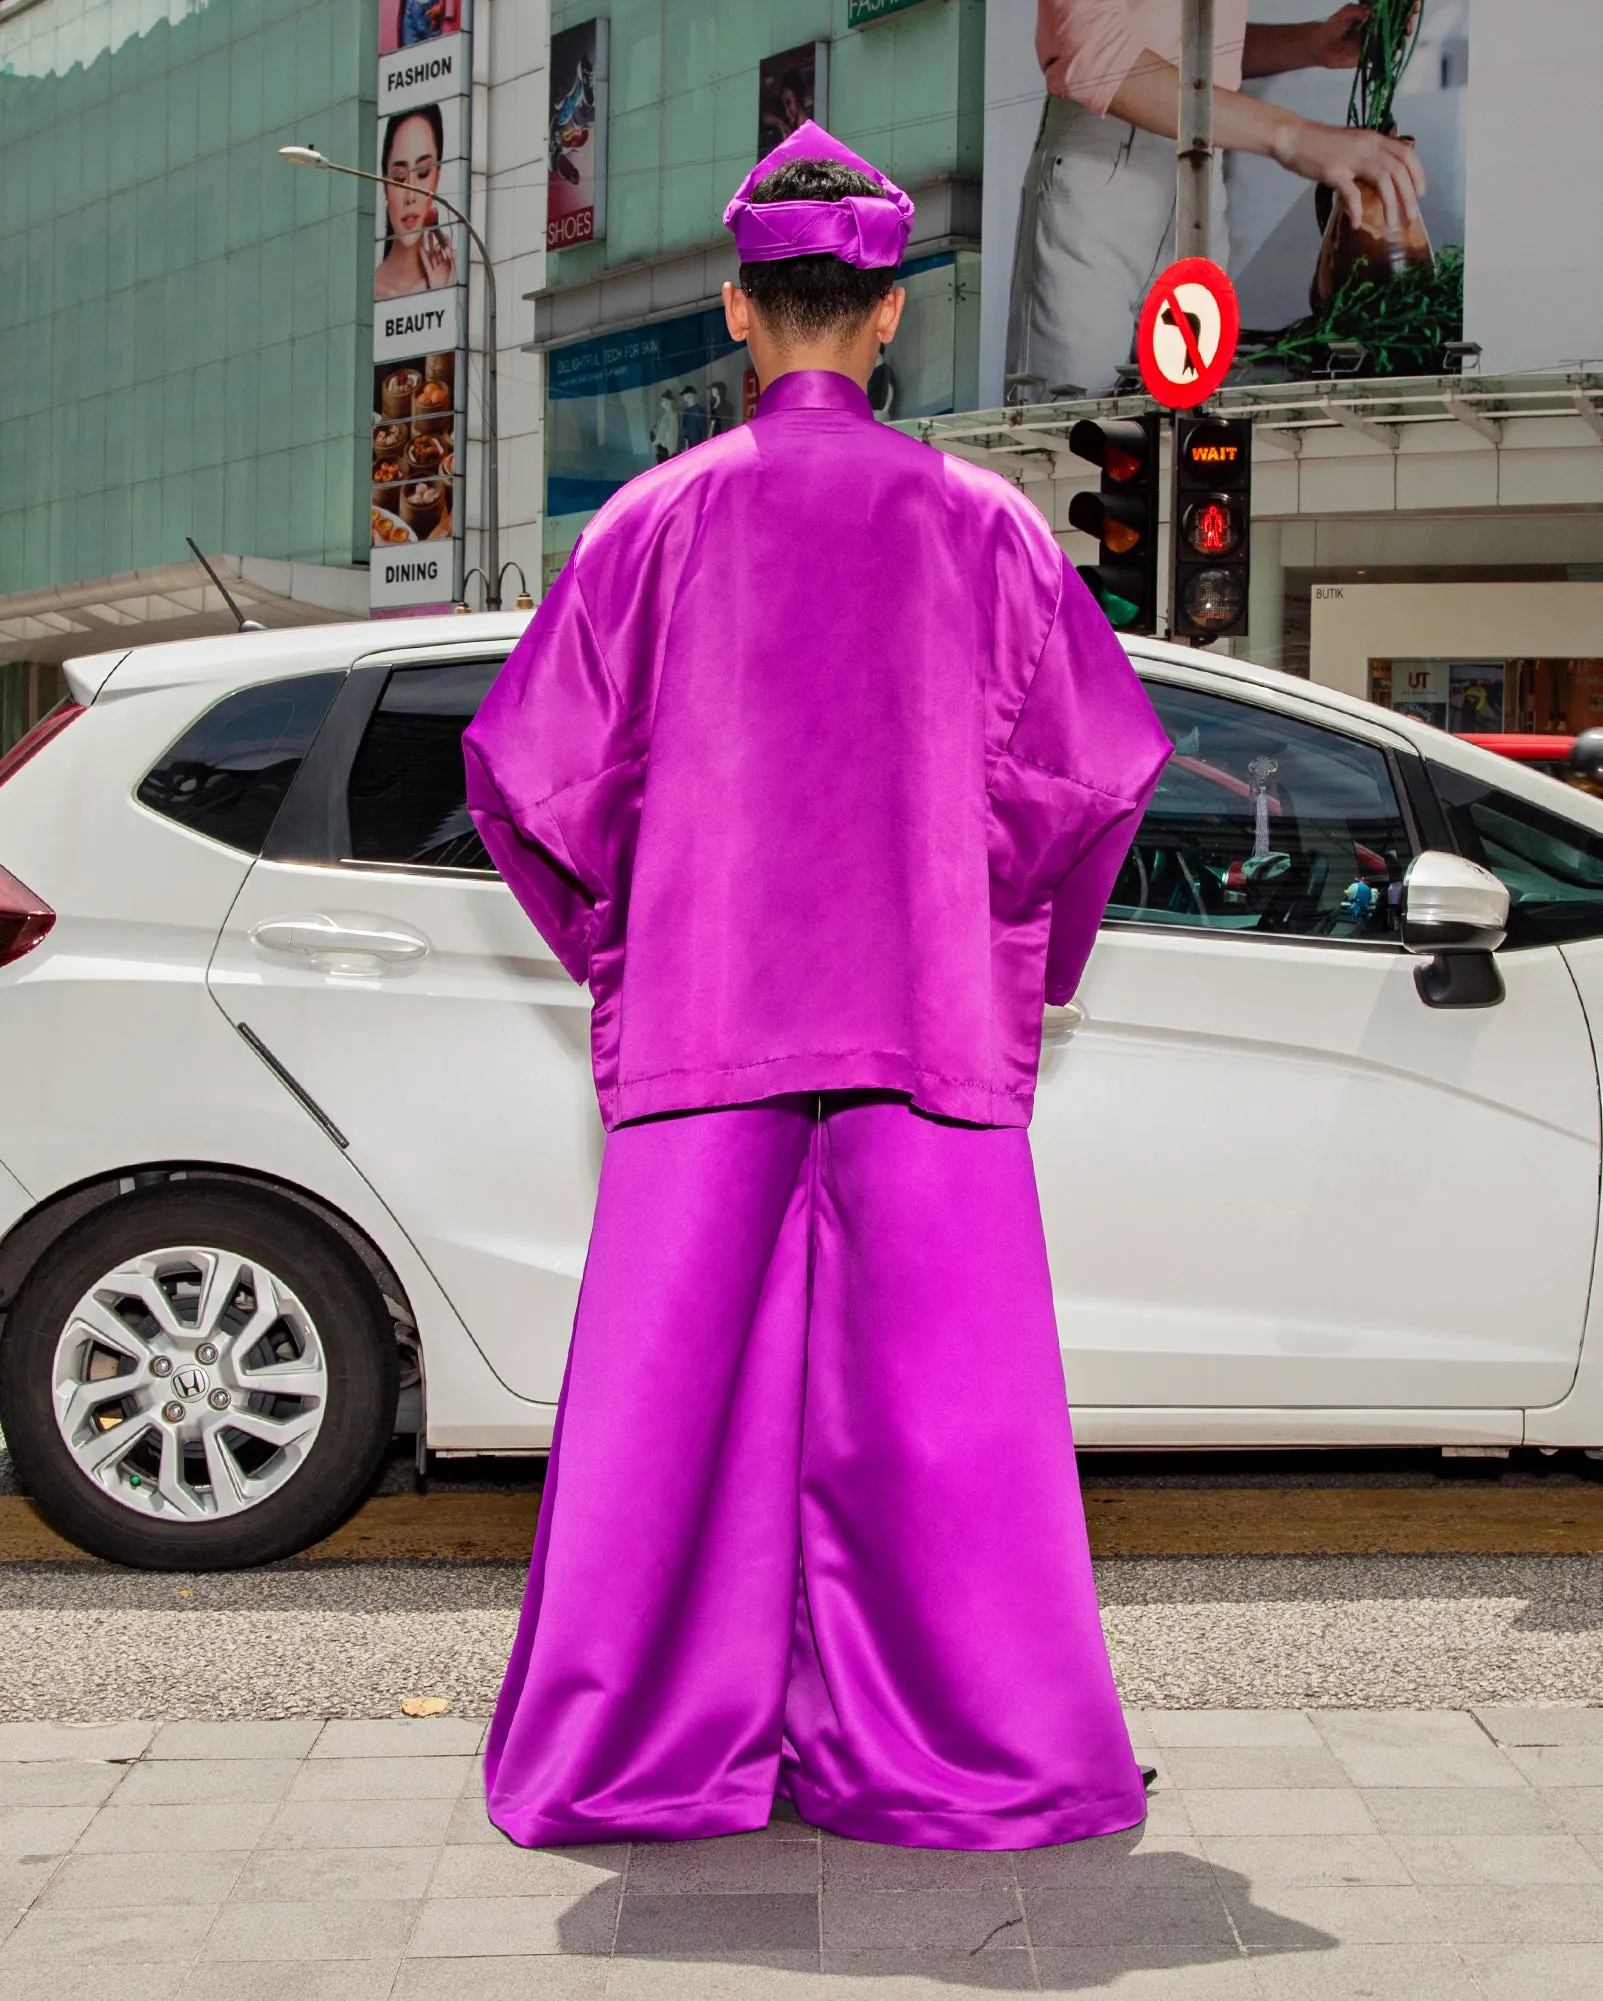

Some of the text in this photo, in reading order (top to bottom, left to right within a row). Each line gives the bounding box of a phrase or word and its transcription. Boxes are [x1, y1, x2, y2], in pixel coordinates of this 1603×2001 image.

[387, 56, 452, 92] FASHION
[548, 212, 591, 245] SHOES
[385, 309, 445, 337] BEAUTY
[557, 352, 600, 374] DELIGHTFUL
[624, 343, 640, 360] FOR
[1192, 446, 1238, 461] WAIT
[385, 561, 438, 584] DINING
[1316, 588, 1344, 600] BUTIK
[1408, 672, 1430, 689] UT
